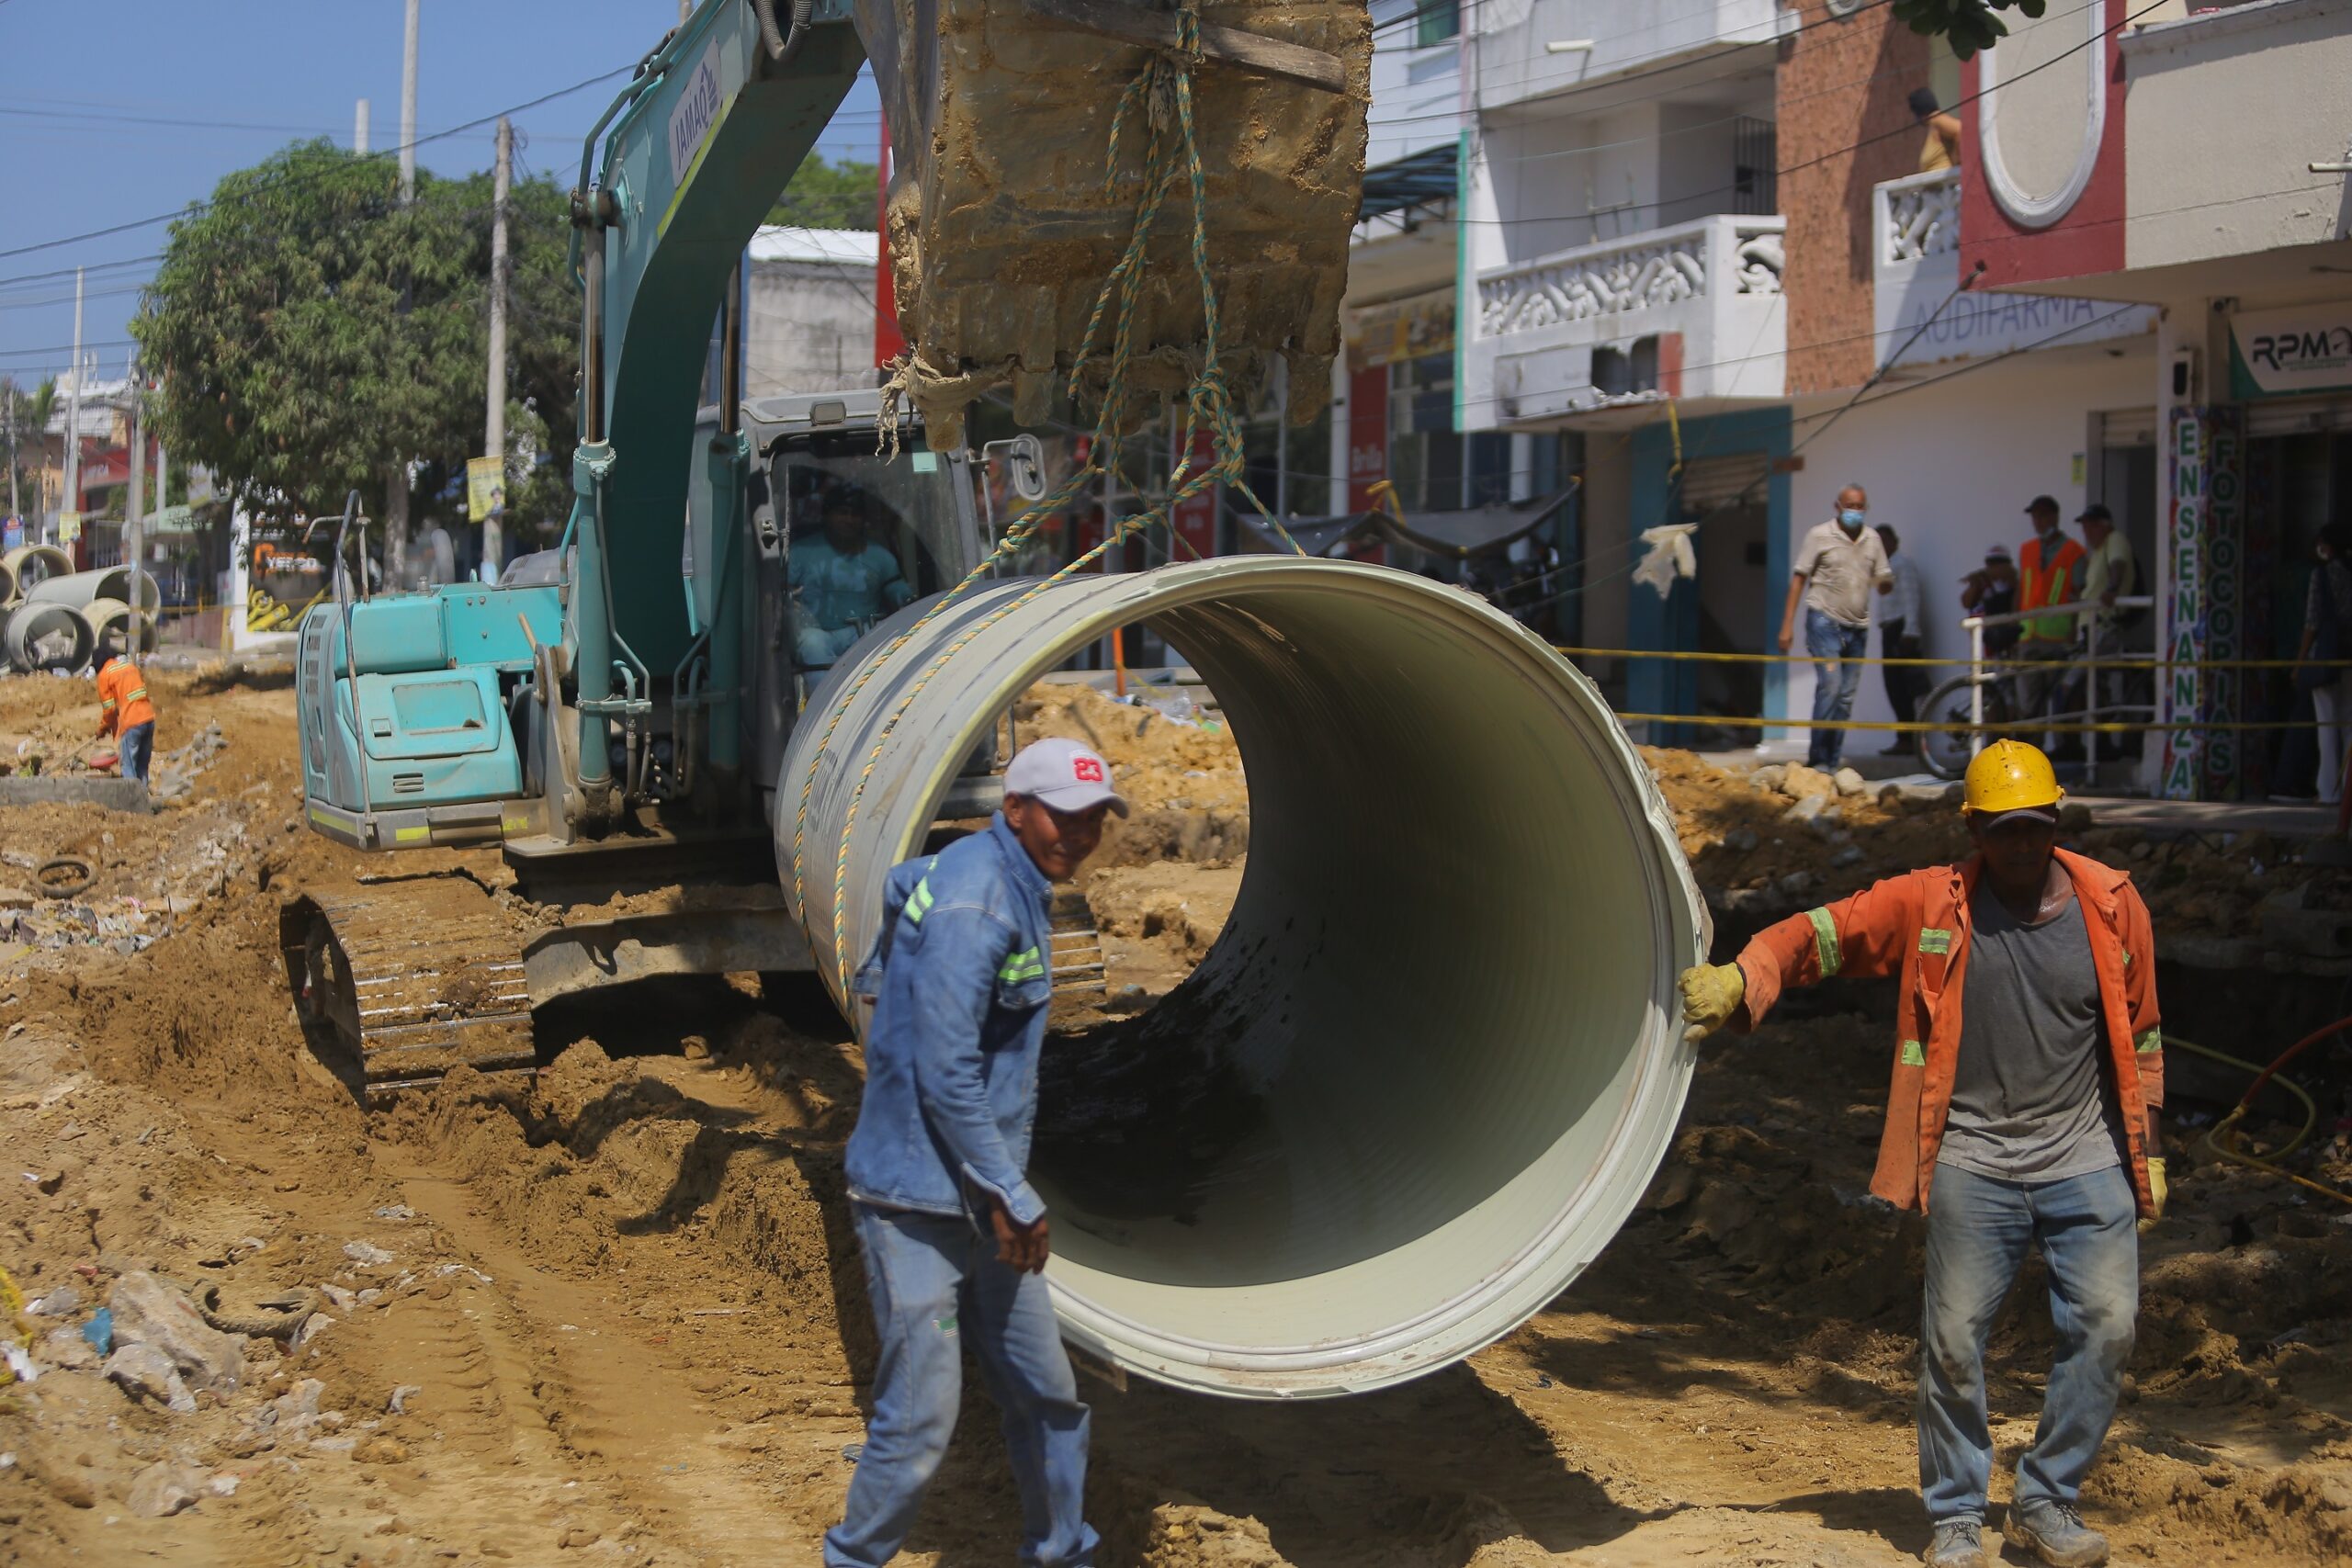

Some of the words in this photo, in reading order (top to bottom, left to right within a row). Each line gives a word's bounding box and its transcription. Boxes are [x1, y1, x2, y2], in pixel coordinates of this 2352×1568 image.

[675, 84, 709, 170] JAMAQ
[1912, 292, 2095, 344] AUDIFARMA
[2253, 330, 2331, 370] RPM
[2168, 422, 2199, 790] ENSEÑANZA
[2209, 439, 2237, 772] FOTOCOPIAS
[1073, 757, 1103, 782] 23
